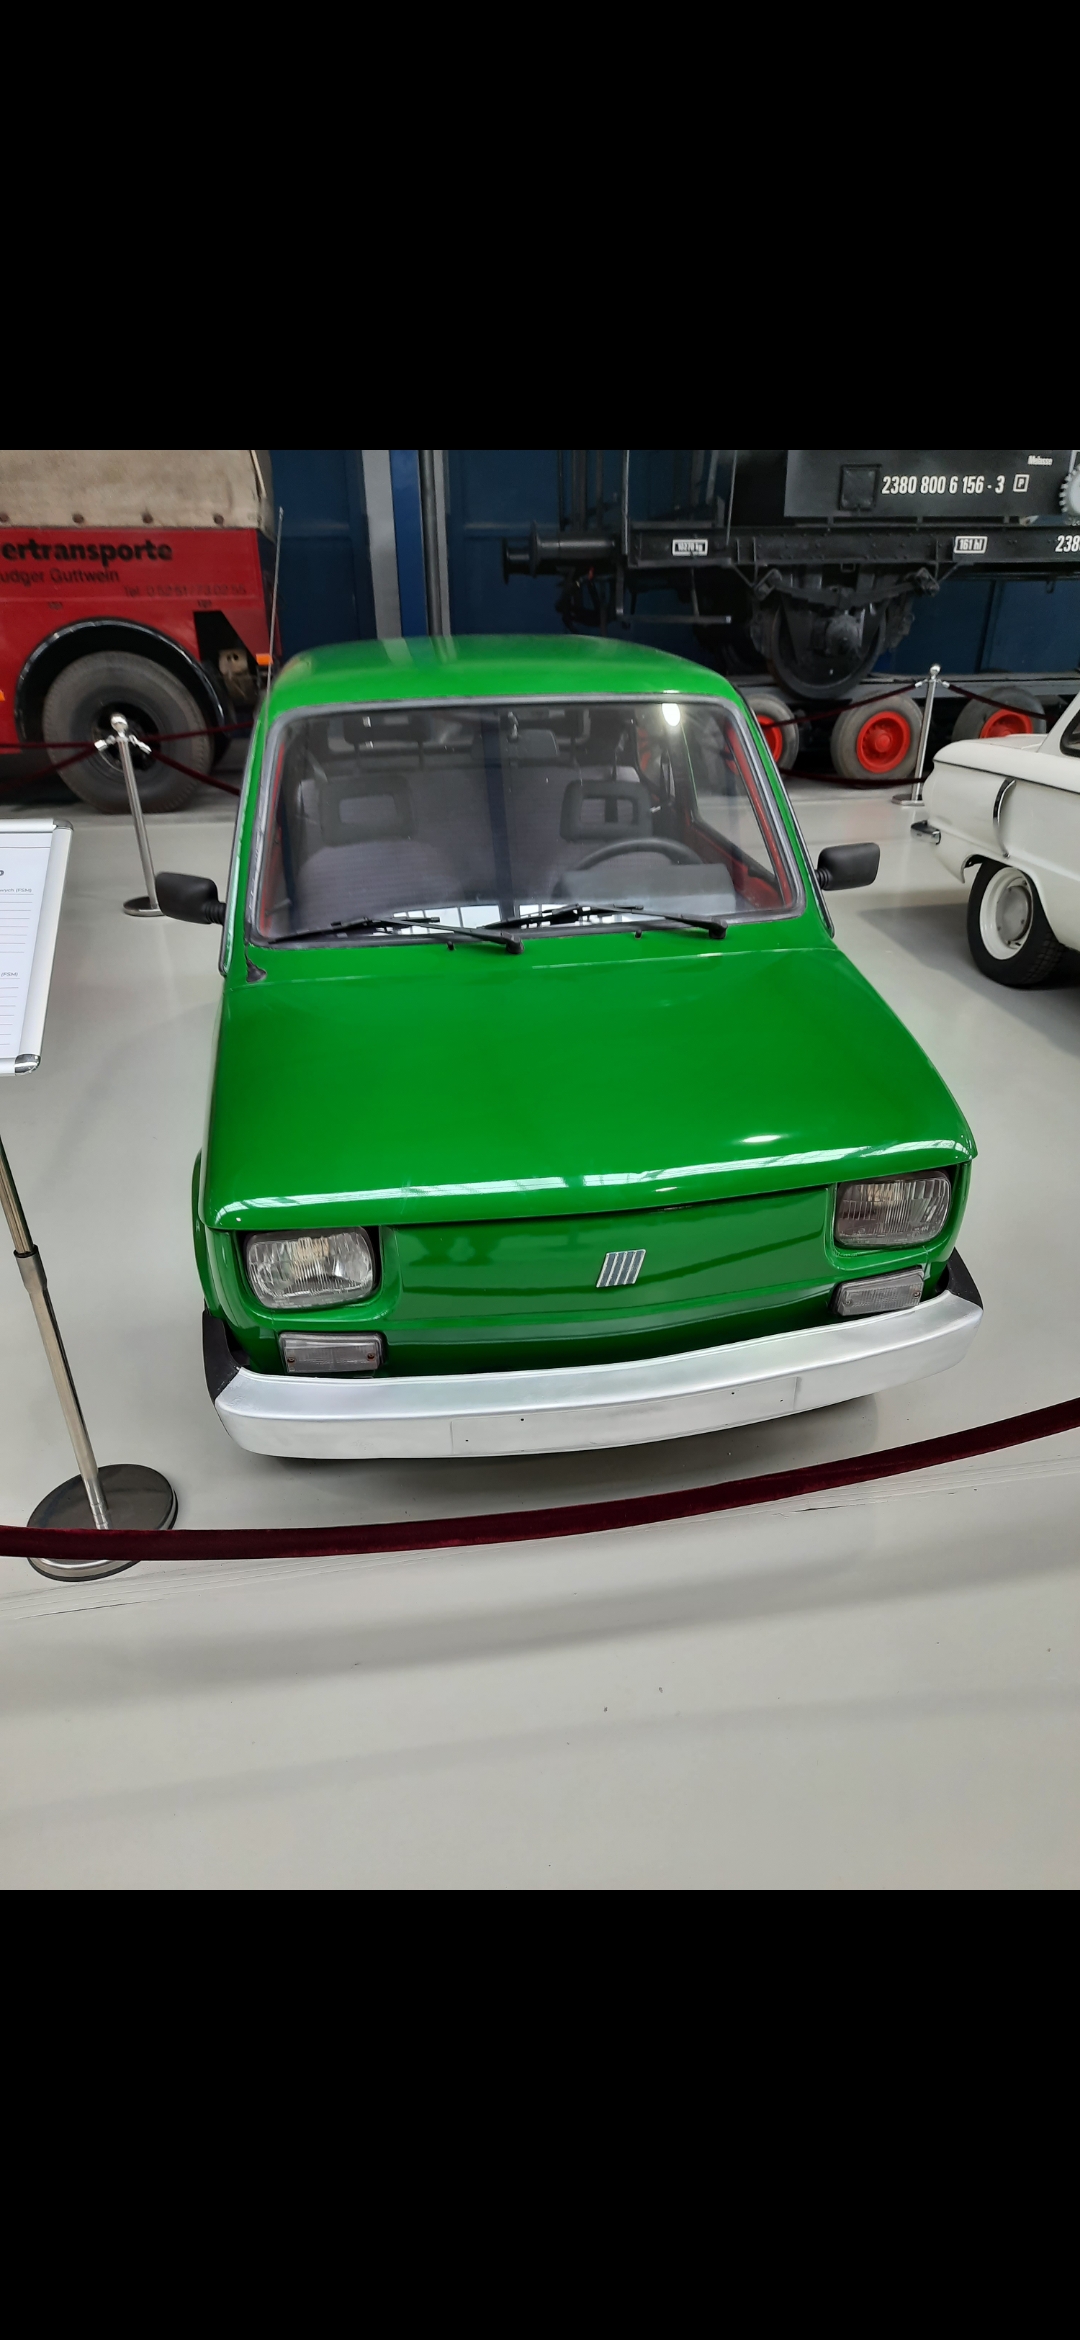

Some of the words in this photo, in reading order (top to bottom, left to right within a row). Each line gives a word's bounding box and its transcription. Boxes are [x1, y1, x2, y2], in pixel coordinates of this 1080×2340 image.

[882, 475, 917, 494] 2380
[920, 475, 946, 494] 800
[949, 475, 959, 494] 6
[962, 475, 984, 494] 156
[995, 475, 1006, 494] 3
[959, 538, 973, 550] 161
[1055, 535, 1080, 552] 238
[1, 538, 173, 567] ertransporte
[49, 568, 120, 583] Guttwein
